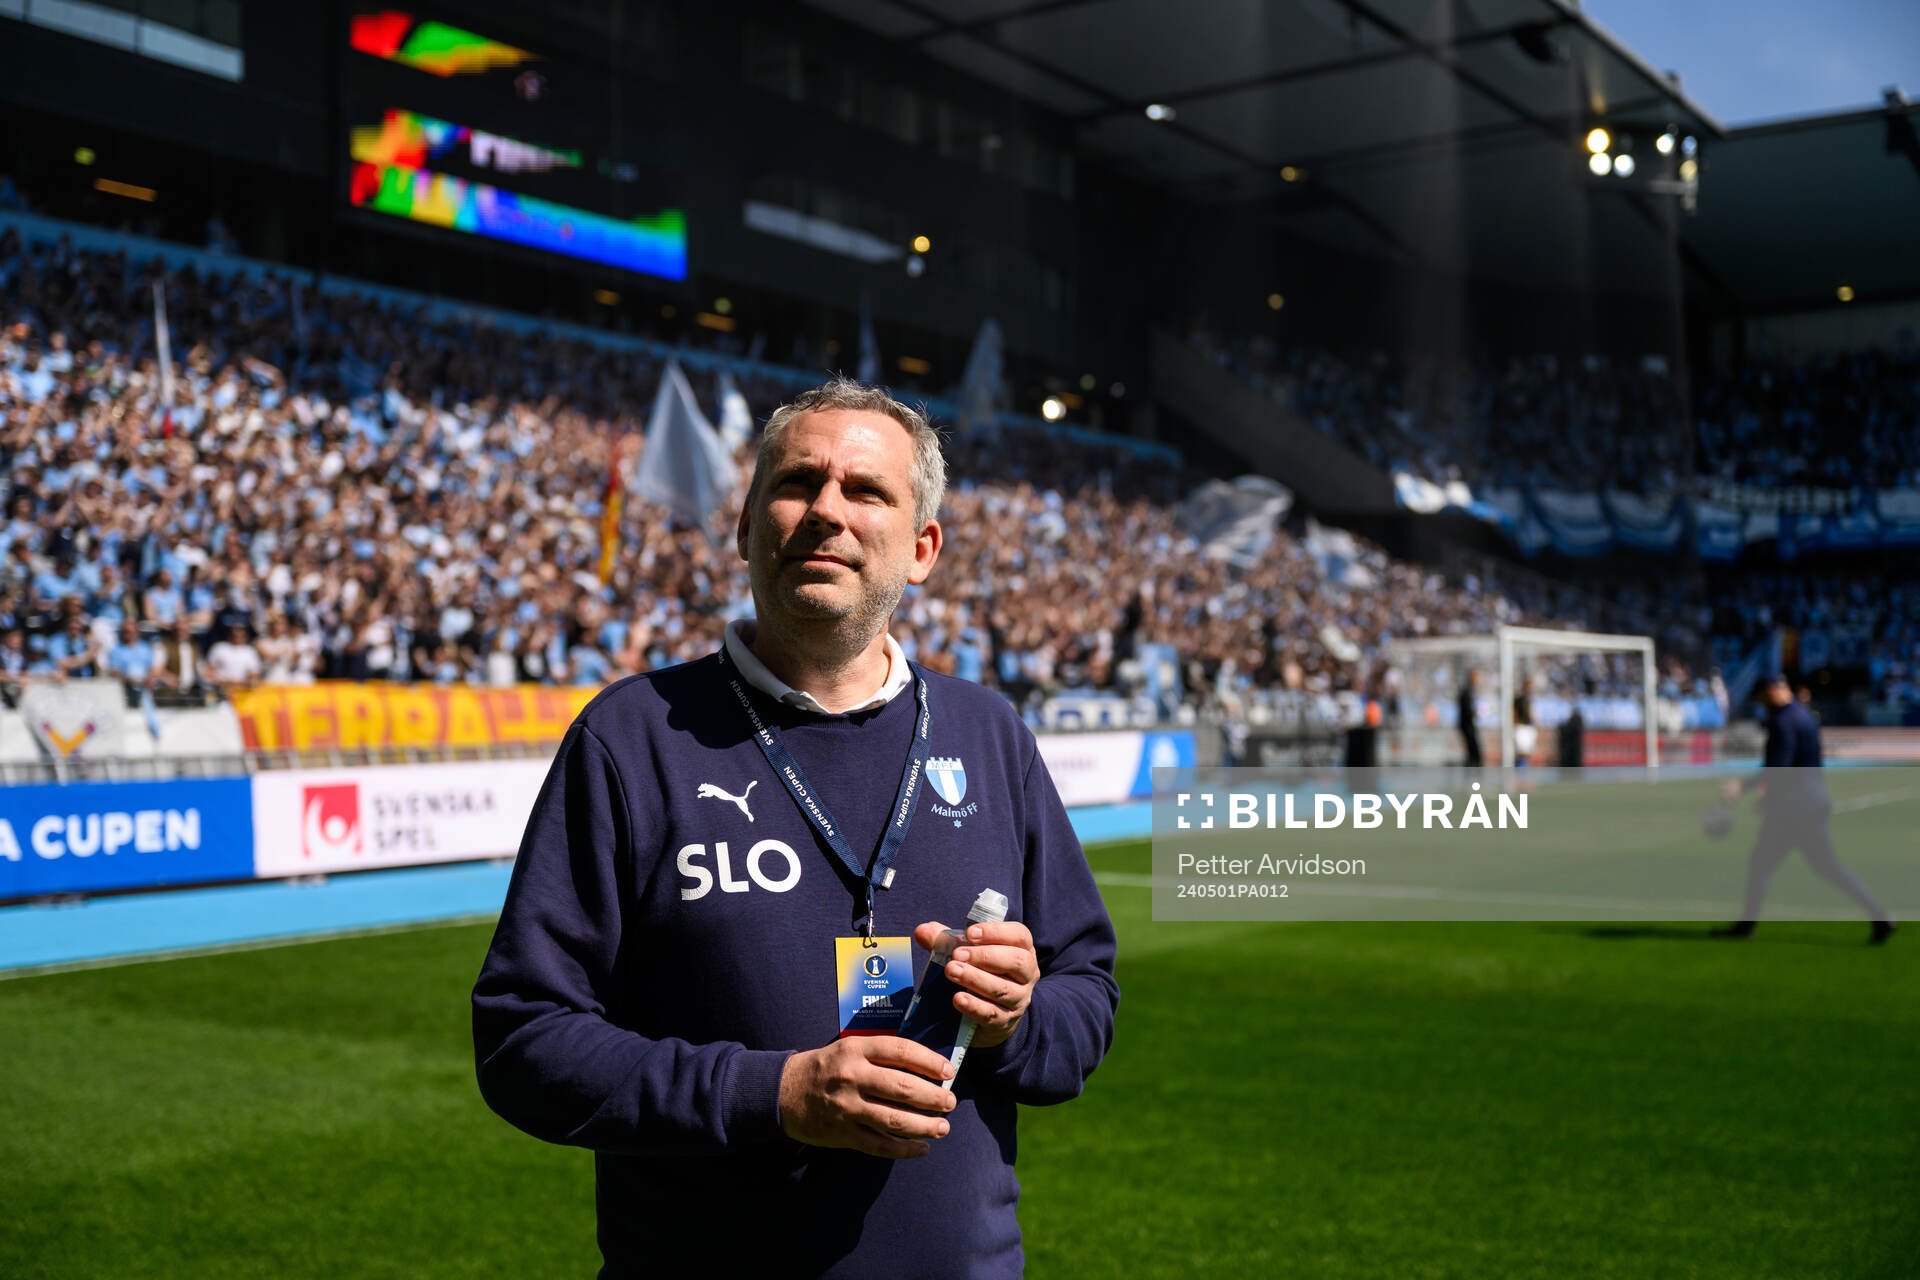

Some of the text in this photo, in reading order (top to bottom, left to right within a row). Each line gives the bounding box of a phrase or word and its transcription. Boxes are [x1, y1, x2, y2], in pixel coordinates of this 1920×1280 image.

[240, 685, 492, 752] TERRA
[730, 680, 774, 746] SVENSKA CUPEN
[373, 790, 497, 817] SVENSKA
[783, 766, 835, 837] SVENSKA CUPEN
[896, 758, 921, 828] SVENSKA CUPEN
[931, 802, 978, 818] Malmö FF
[31, 807, 201, 860] CUPEN
[374, 827, 437, 849] SPEL
[676, 839, 802, 901] SLO
[862, 995, 893, 1008] FINAL
